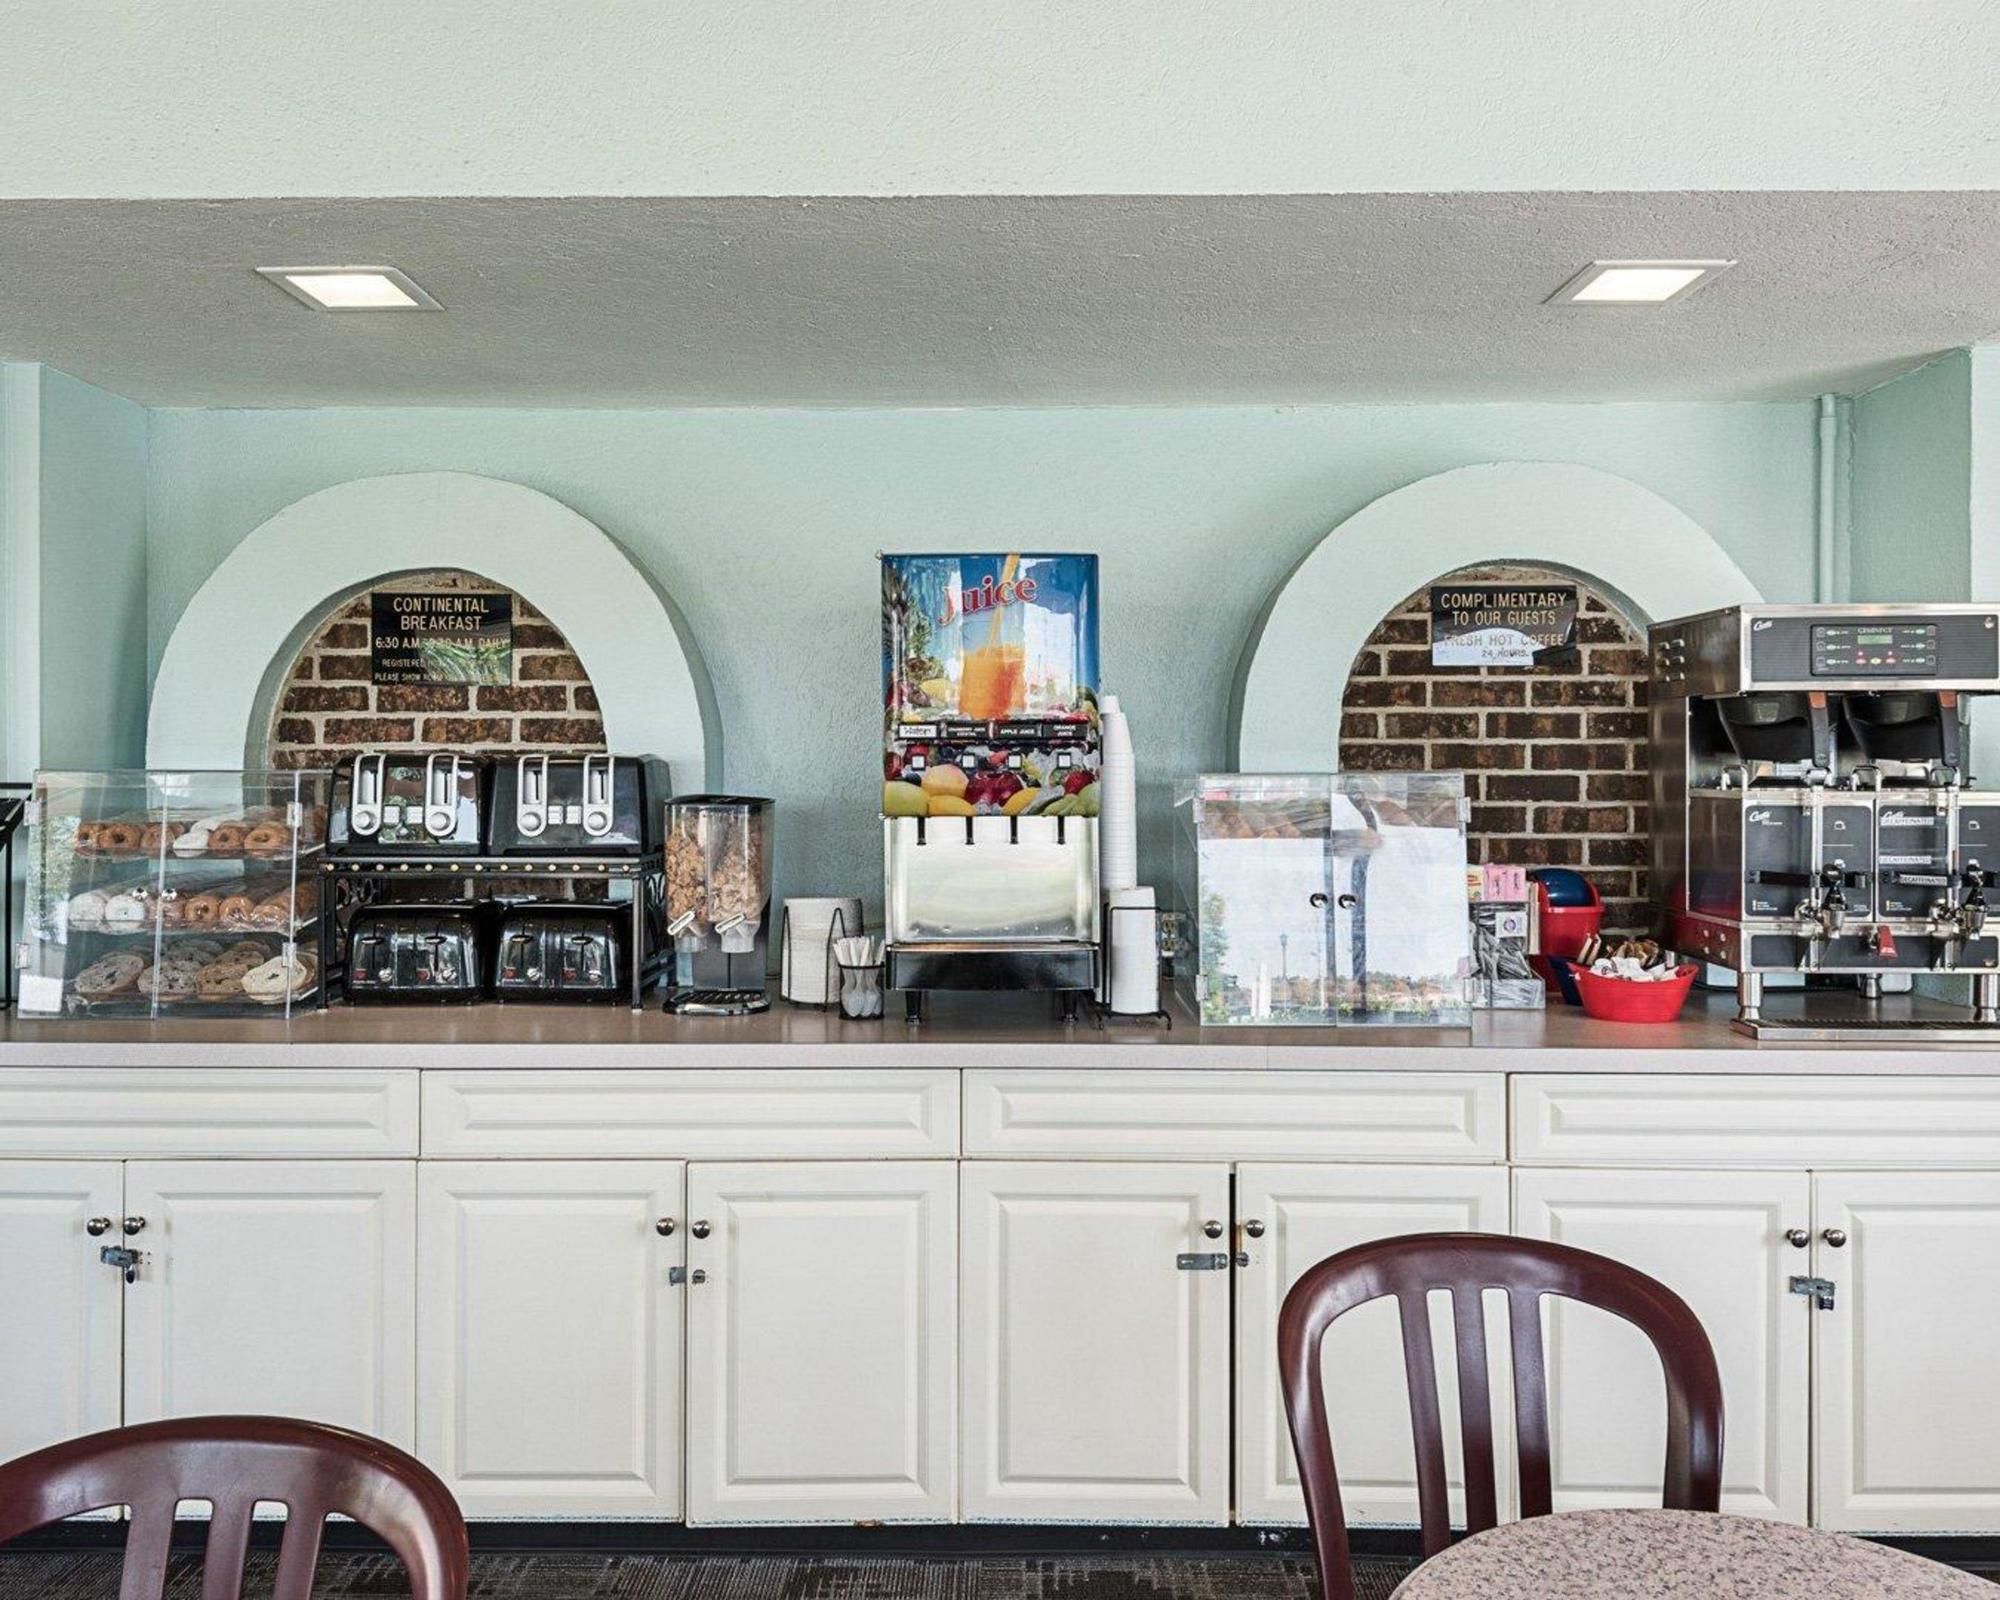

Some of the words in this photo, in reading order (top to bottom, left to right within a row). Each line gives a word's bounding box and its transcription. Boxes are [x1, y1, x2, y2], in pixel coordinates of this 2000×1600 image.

[393, 597, 490, 613] CONTINENTAL
[937, 574, 1038, 627] Juice
[1441, 592, 1567, 608] COMPLIMENTARY
[401, 615, 482, 631] BREAKFAST
[1452, 611, 1470, 626] TO
[1475, 611, 1501, 625] OUR
[1507, 610, 1556, 625] GUESTS
[375, 636, 399, 649] 6:30
[1444, 634, 1482, 647] FRESH
[1488, 634, 1514, 646] HOT
[1521, 633, 1565, 646] COFFEE
